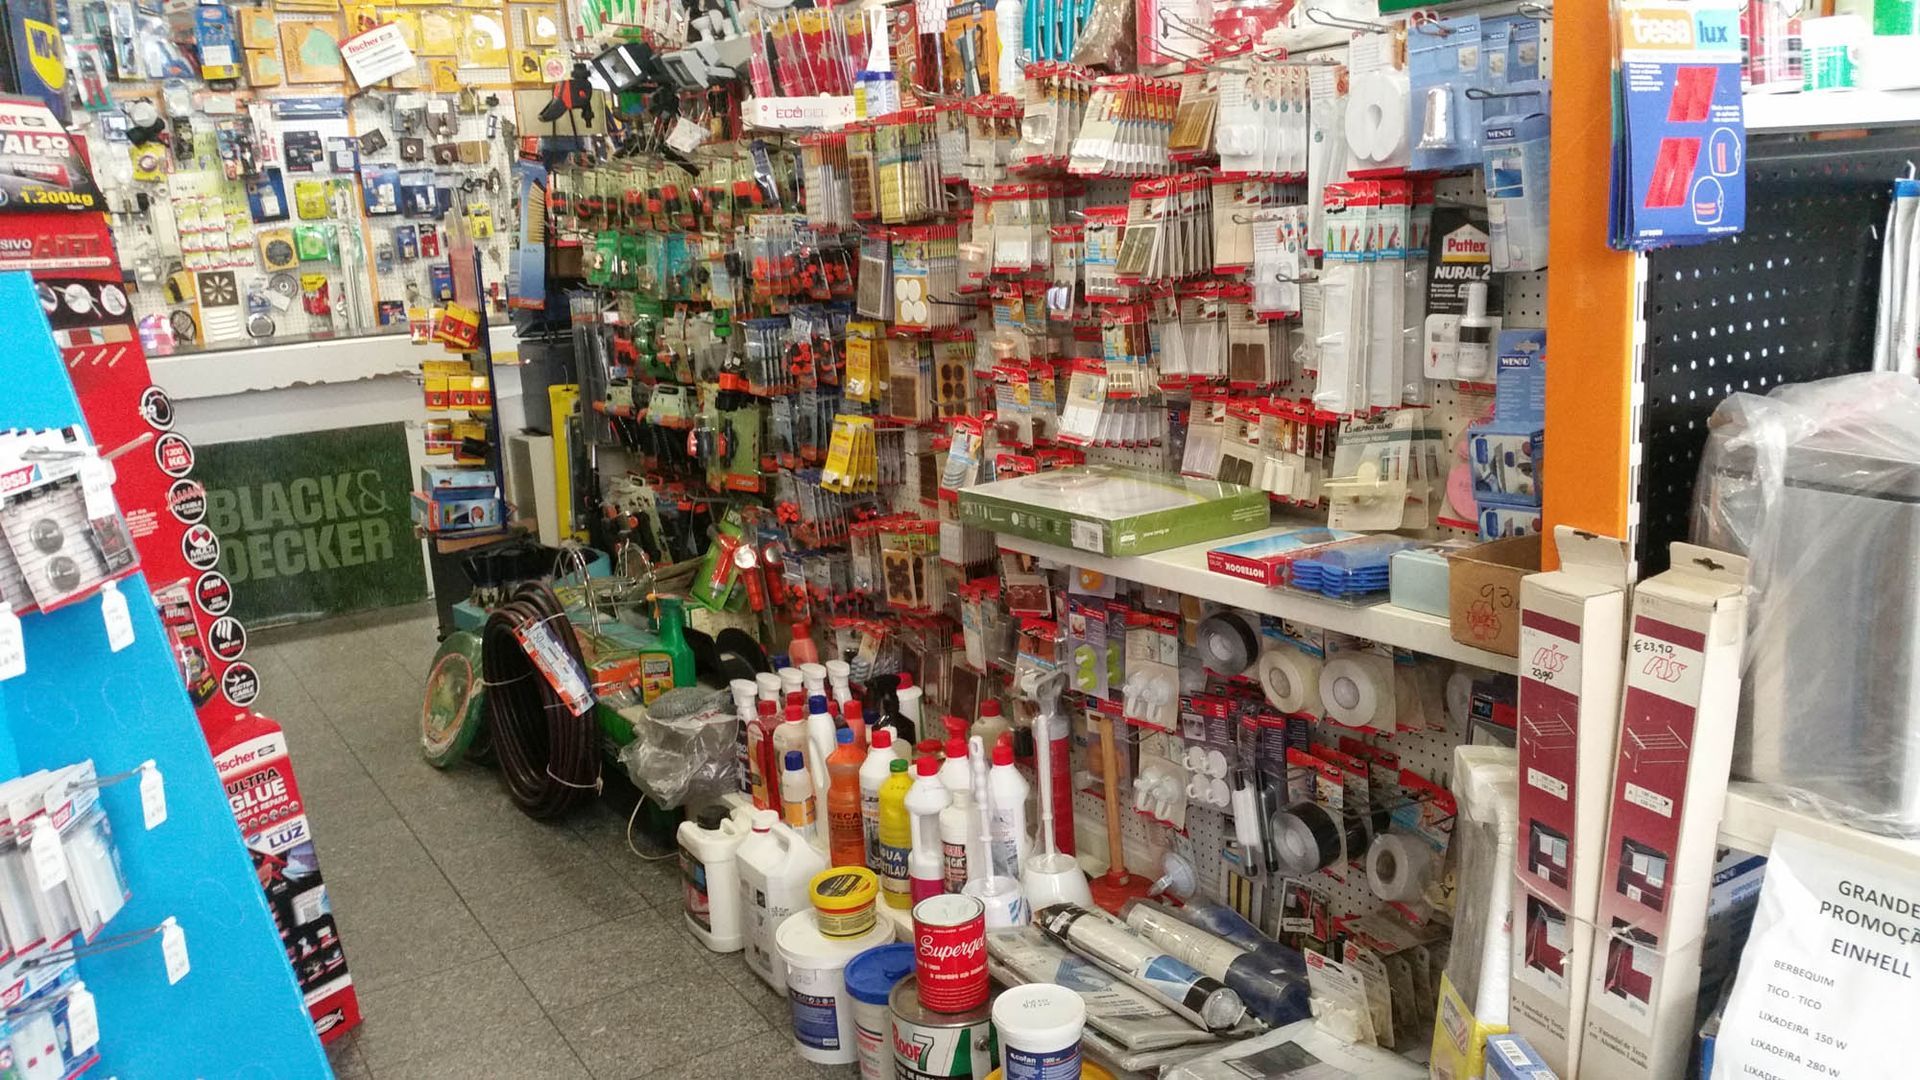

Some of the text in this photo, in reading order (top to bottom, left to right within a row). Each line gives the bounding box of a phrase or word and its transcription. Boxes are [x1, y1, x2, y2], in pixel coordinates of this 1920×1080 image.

[1631, 11, 1728, 45] tesa lux
[20, 191, 94, 206] 1.200kg
[1447, 237, 1486, 253] Pattex
[1434, 264, 1491, 280] NURAL 2
[216, 517, 394, 584] DECKER
[1224, 561, 1265, 578] NOTEBOOK
[227, 767, 279, 796] ULTRA
[229, 777, 287, 814] GLUE
[269, 825, 305, 848] LUZ
[1837, 879, 1920, 920] GRANDE
[1773, 959, 1835, 988] BERBEQUIM
[1830, 937, 1912, 979] EINHELL
[1766, 983, 1790, 1000] TICO
[1799, 995, 1822, 1011] TICO
[1758, 1010, 1848, 1051] LIXADEIRA 150 W
[912, 1033, 935, 1072] 7
[1750, 1037, 1841, 1079] LIXADEIRA 280 W
